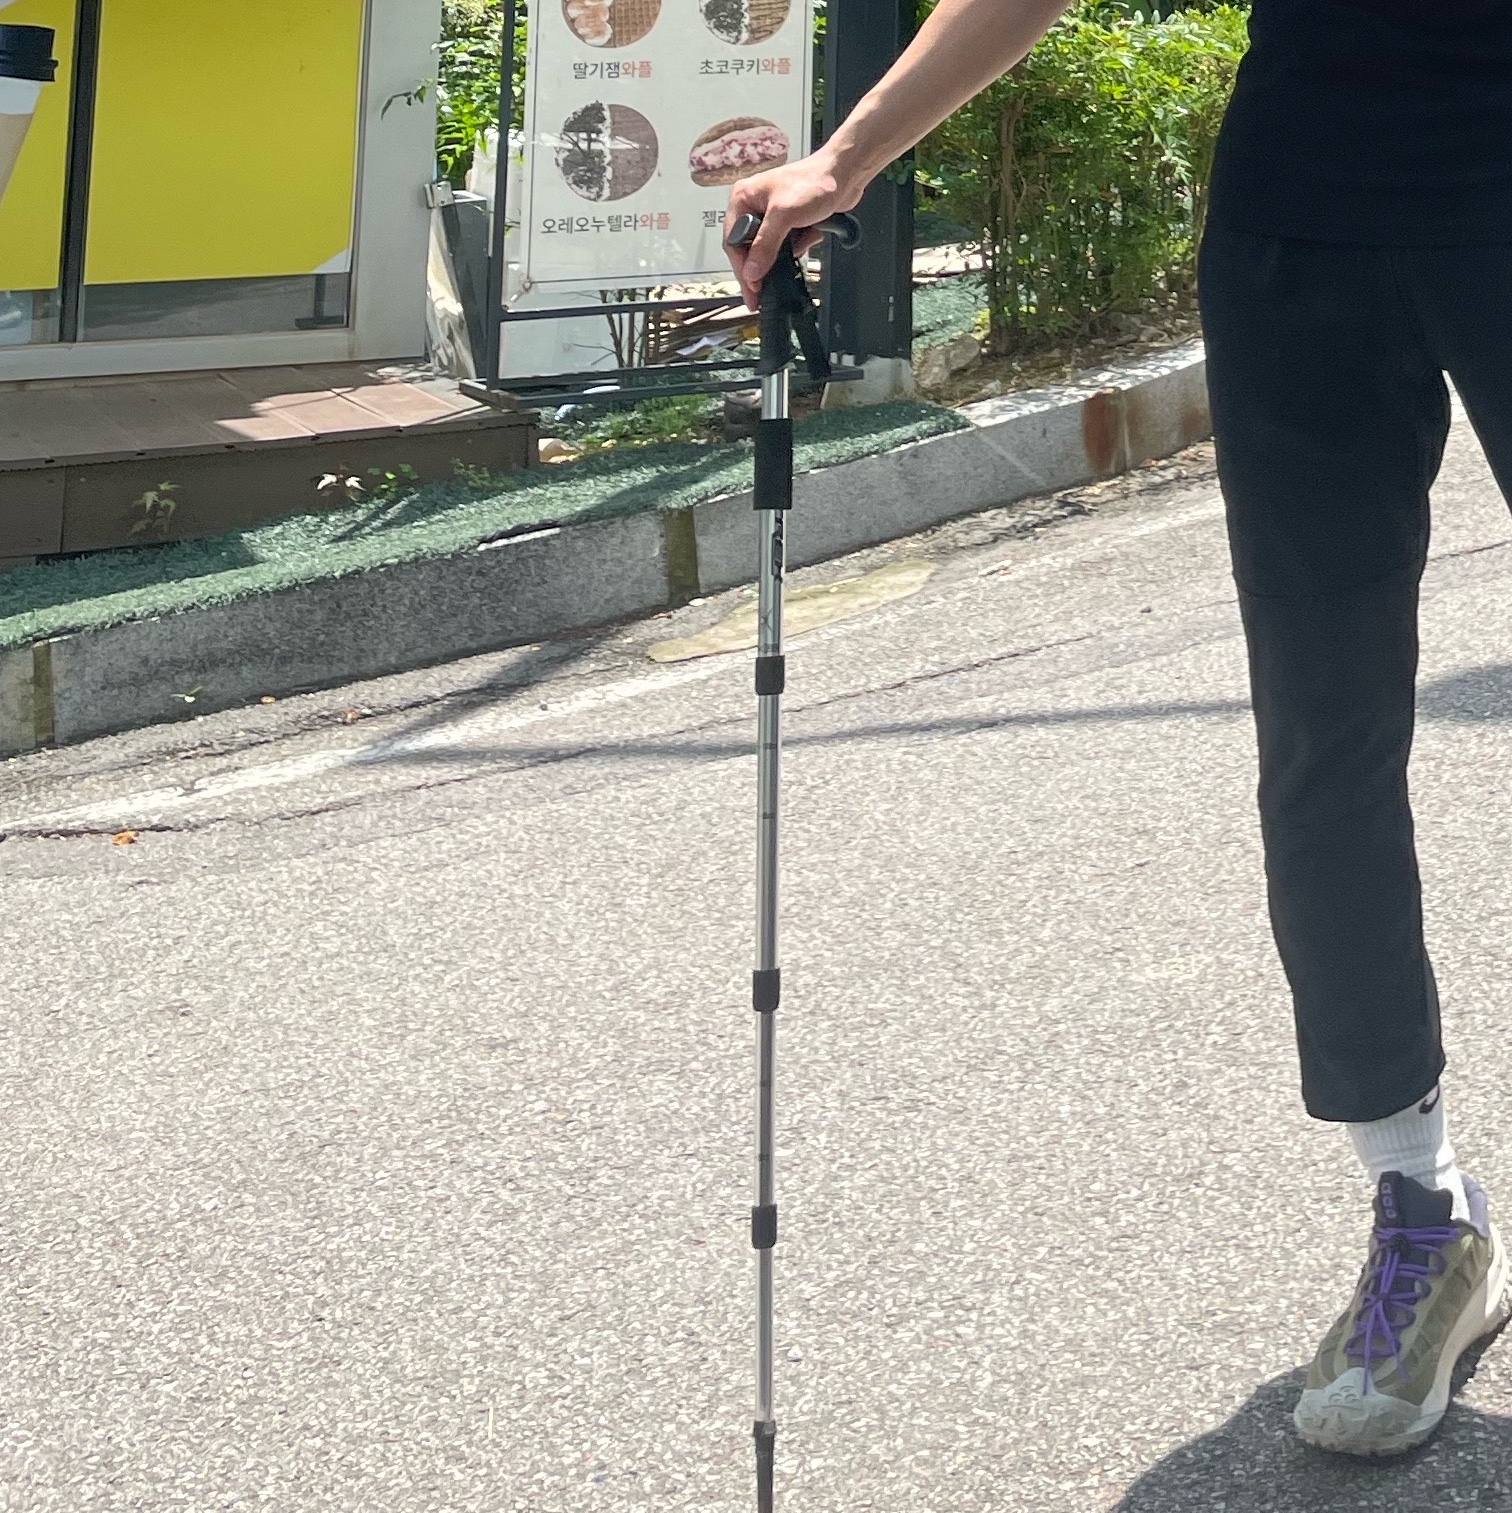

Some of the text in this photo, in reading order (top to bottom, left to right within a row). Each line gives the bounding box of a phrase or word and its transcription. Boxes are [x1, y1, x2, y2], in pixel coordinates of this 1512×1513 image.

[572, 60, 653, 80] 딸기잼와플
[698, 57, 791, 76] 초코쿠키와플
[540, 212, 671, 234] 오레오누텔라와플
